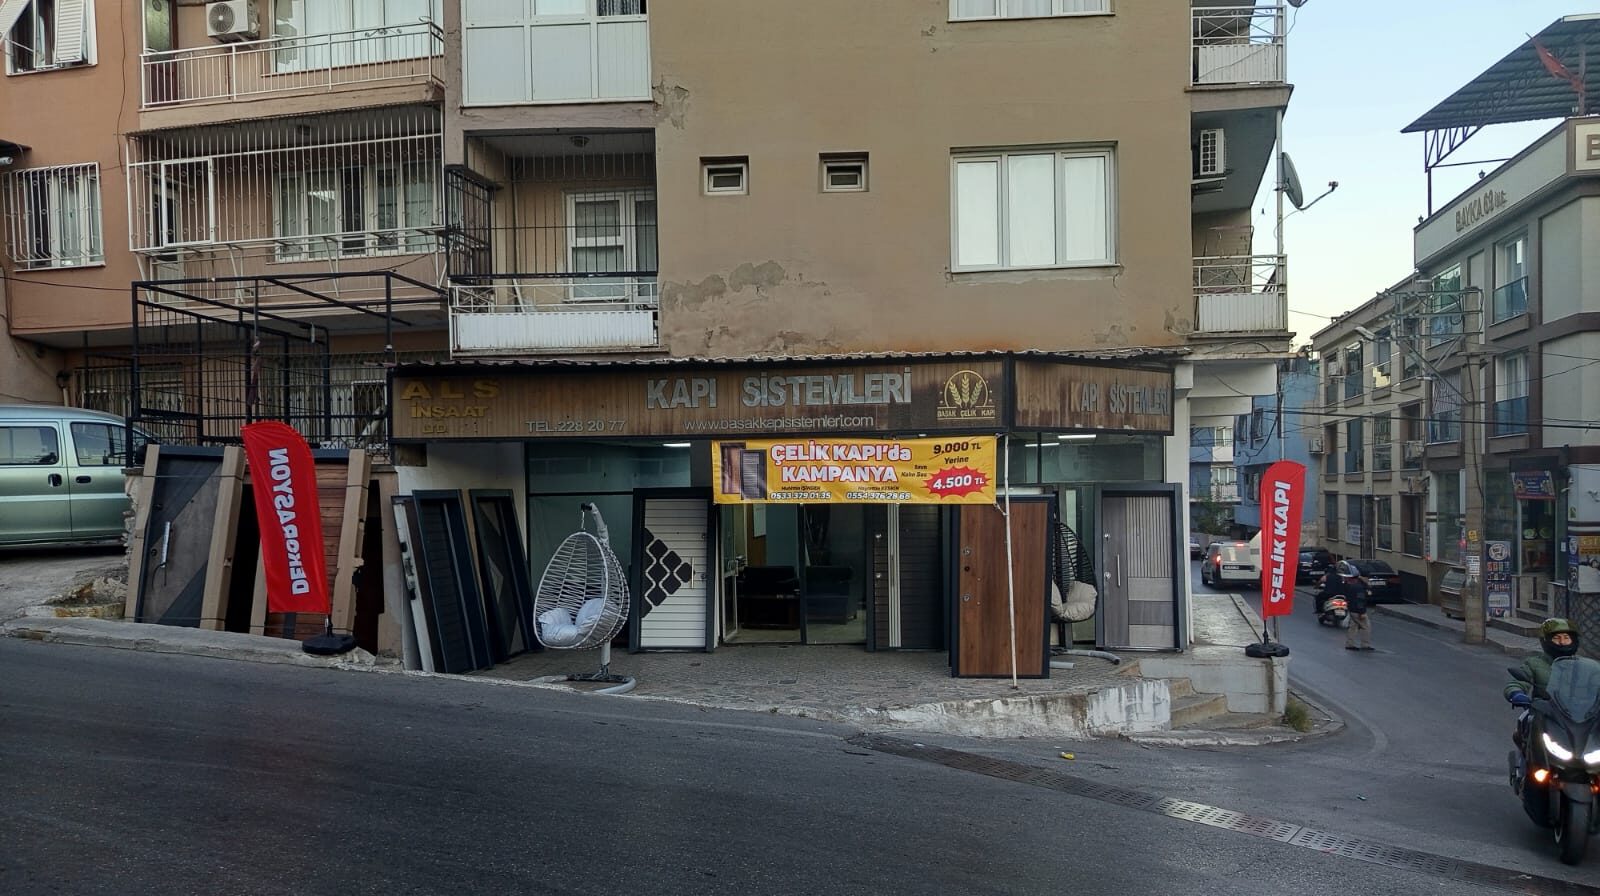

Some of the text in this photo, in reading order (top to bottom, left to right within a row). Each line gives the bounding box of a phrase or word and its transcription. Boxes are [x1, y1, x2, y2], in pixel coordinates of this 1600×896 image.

[647, 366, 912, 409] KAPI SİSTEMLERİ
[587, 420, 605, 431] 20
[609, 420, 625, 431] 77
[683, 414, 874, 431] www.basakkapisistemleri.com
[771, 440, 912, 466] ÇELİK KAPI'da
[933, 442, 982, 455] 9.000 TL
[944, 456, 969, 465] Yerine
[782, 466, 898, 482] KAMPANYA
[933, 475, 972, 490] 4.500
[1270, 481, 1291, 603] ÇELİK KAPI
